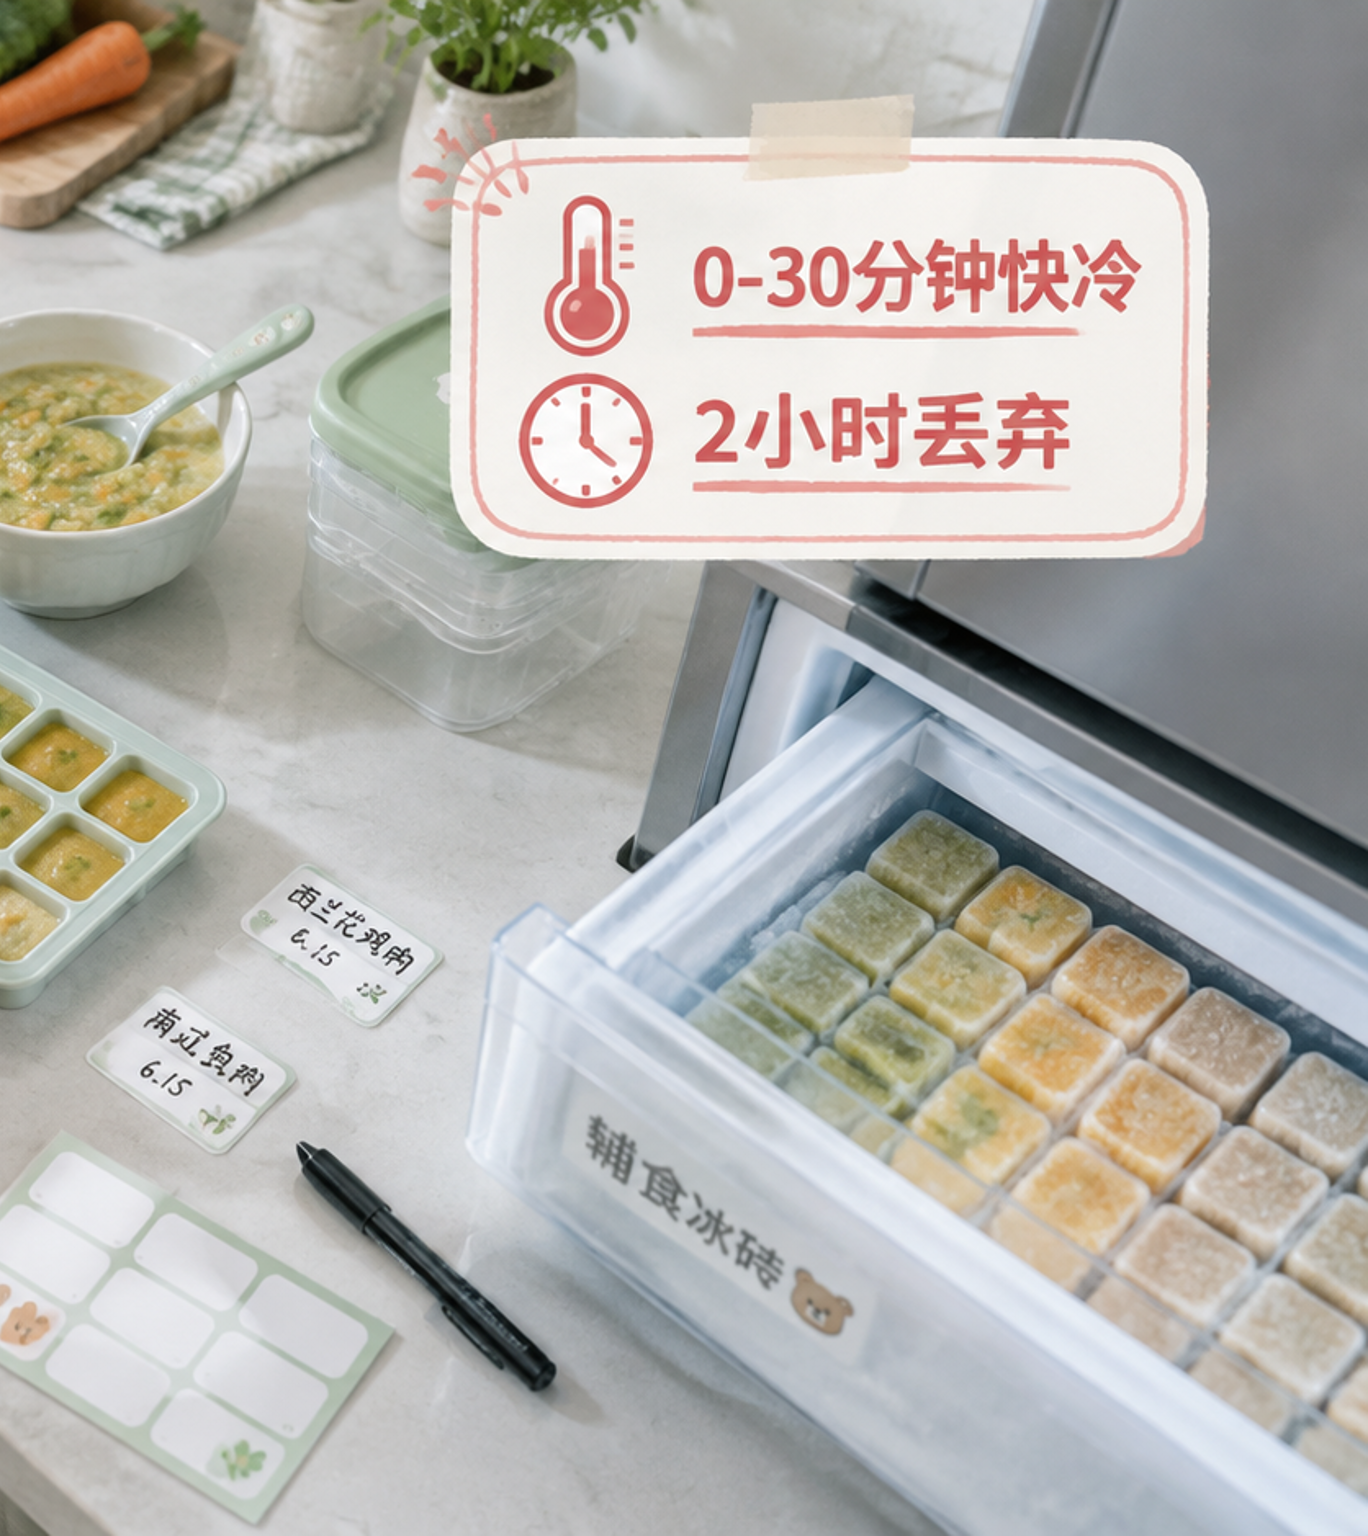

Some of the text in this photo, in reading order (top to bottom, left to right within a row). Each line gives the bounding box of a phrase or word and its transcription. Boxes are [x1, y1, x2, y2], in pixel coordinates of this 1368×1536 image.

[140, 1061, 192, 1096] 6.15
[585, 1115, 784, 1290] 辅食冰砖
